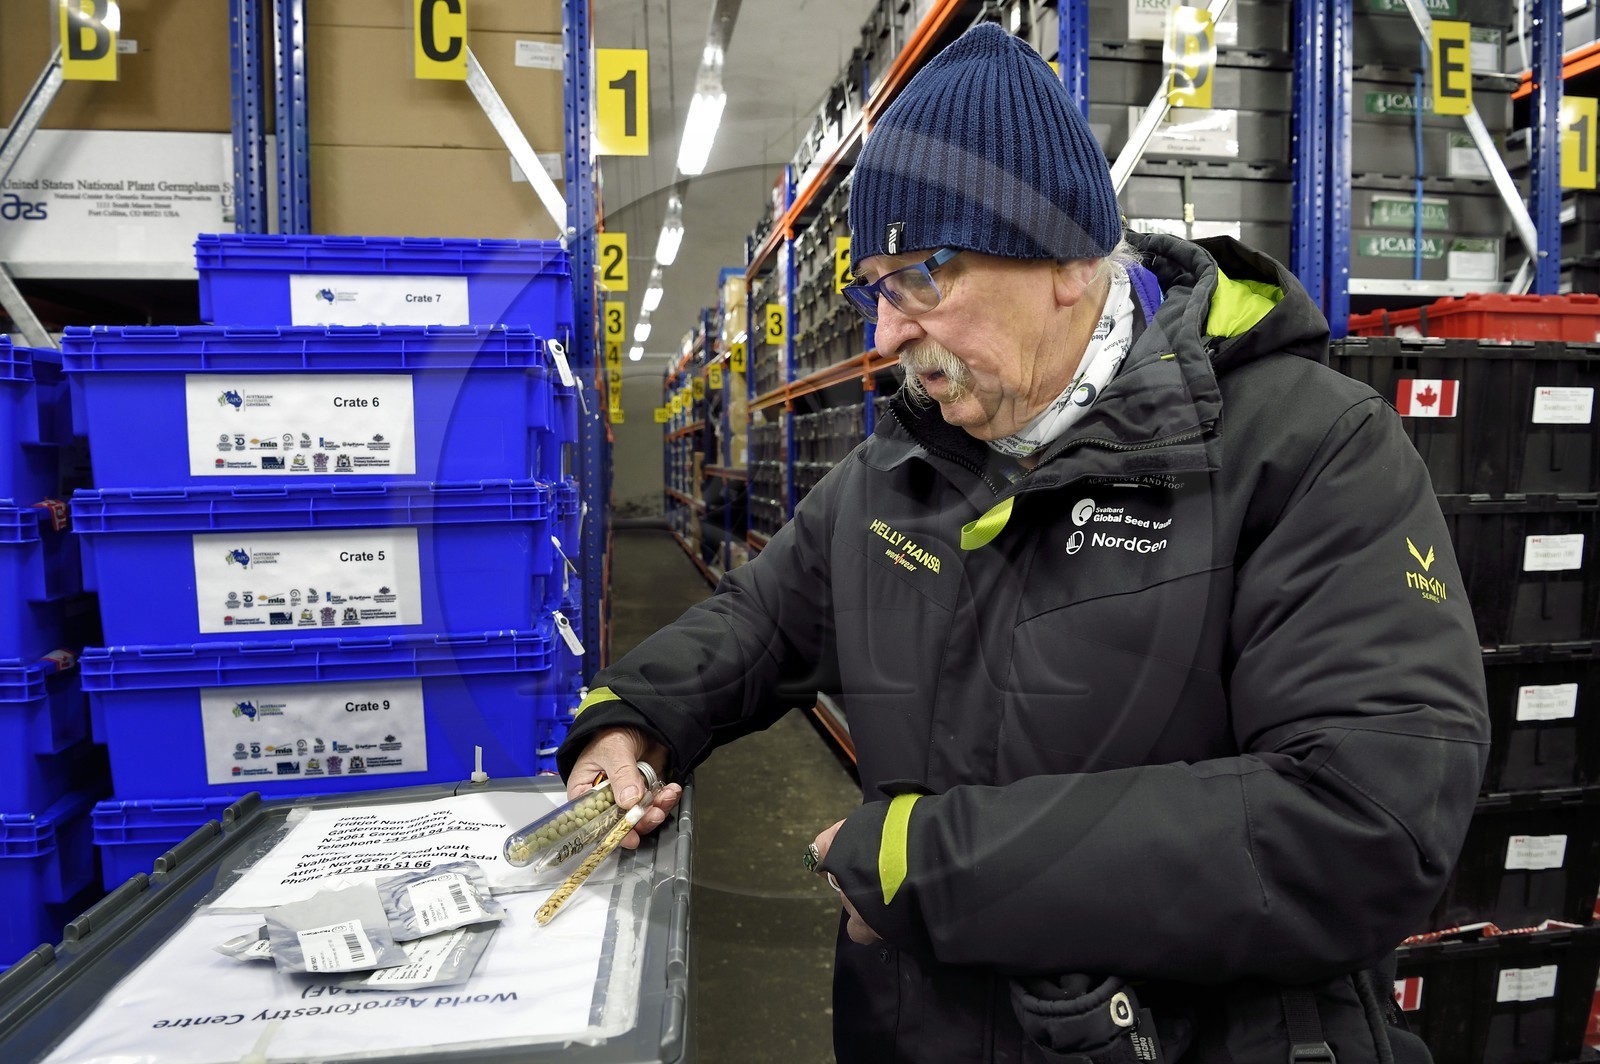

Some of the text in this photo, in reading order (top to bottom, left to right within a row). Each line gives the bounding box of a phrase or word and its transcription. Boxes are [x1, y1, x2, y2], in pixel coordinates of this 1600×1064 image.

[68, 0, 110, 60] B
[420, 0, 462, 62] C
[1439, 38, 1466, 98] E
[609, 70, 637, 137] 1
[1570, 115, 1588, 172] 1
[2, 179, 39, 191] United
[42, 179, 74, 190] States
[77, 179, 124, 191] National
[127, 180, 155, 191] Plant
[157, 181, 221, 194] Germplasm
[603, 244, 624, 281] 2
[405, 294, 442, 303] Crate 7
[608, 309, 622, 334] 3
[770, 312, 783, 337] 3
[608, 347, 619, 365] 4
[733, 348, 743, 366] 4
[711, 367, 720, 381] 5
[333, 396, 380, 408] Crate 6
[869, 518, 906, 547] HELLY
[1093, 514, 1173, 530] Global Seed Vault
[1091, 532, 1167, 554] NordGen
[340, 551, 385, 562] Crate 5
[1406, 571, 1447, 600] MAGNI
[345, 700, 390, 713] Crate 9
[322, 832, 366, 843] N-2061
[369, 820, 446, 838] Gardermoen
[459, 820, 507, 829] Norway
[328, 815, 449, 837] Gardermoen airport
[334, 819, 378, 829] Fridtjof
[316, 838, 382, 851] Telephone
[410, 831, 427, 841] 63
[286, 864, 325, 877] Attn.:
[328, 855, 389, 869] NordGen
[402, 850, 457, 860] Asmund
[461, 852, 498, 861] Asdal
[296, 852, 352, 869] Svalbard
[435, 843, 471, 851] Vault
[280, 872, 323, 885] Phone
[354, 864, 371, 873] 91
[373, 862, 391, 871] 36
[393, 860, 411, 869] 51
[413, 859, 432, 869] 66
[151, 990, 519, 1029] World Agroforestry Centre
[1139, 1036, 1152, 1060] MICRO
